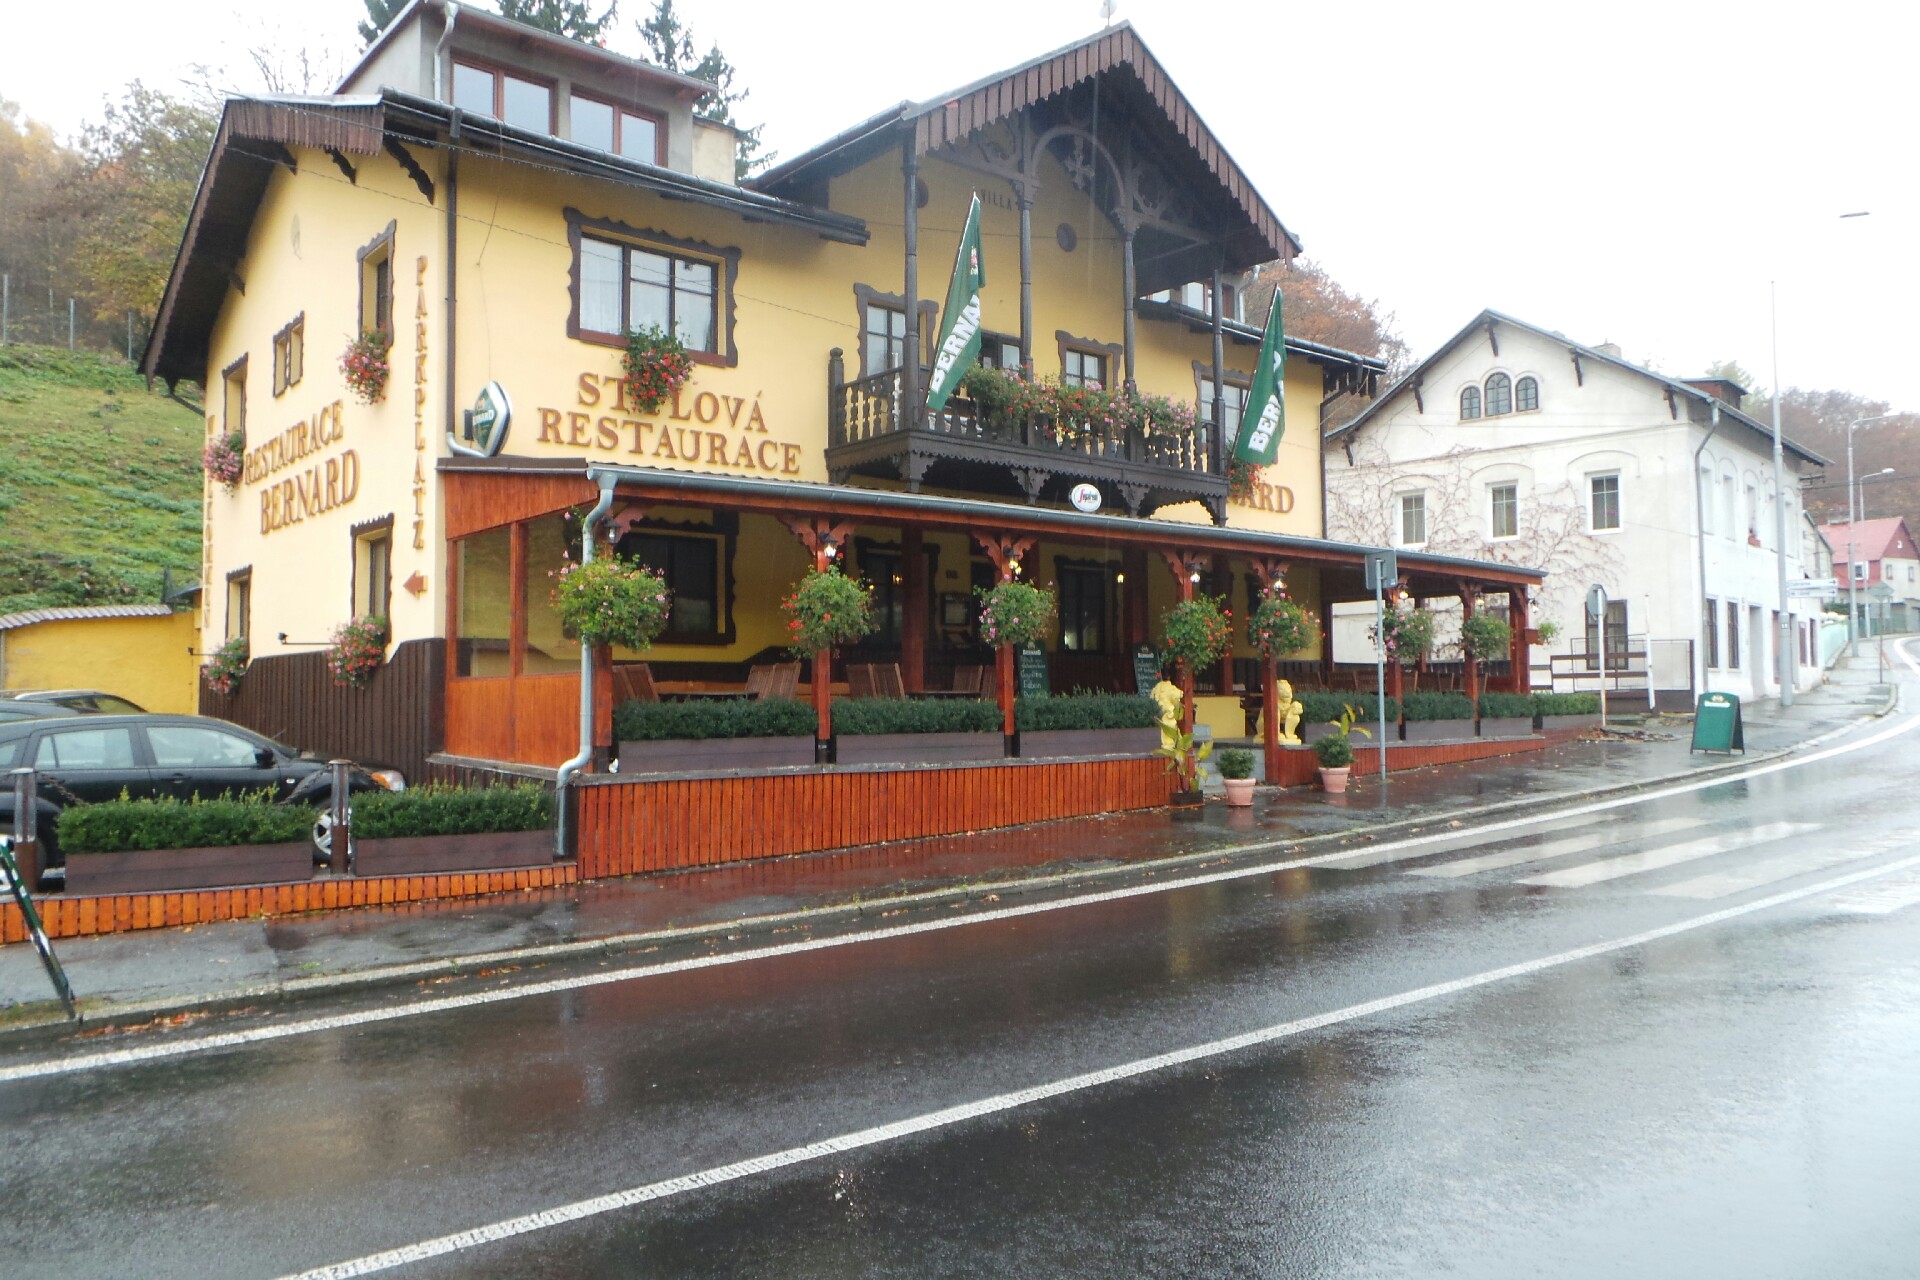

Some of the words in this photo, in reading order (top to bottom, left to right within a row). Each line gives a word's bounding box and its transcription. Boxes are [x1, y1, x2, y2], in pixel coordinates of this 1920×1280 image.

[244, 399, 344, 486] RESTAURACE
[413, 255, 428, 549] PARKPLATZ
[537, 406, 802, 474] RESTAURACE
[577, 371, 769, 433] STLOVÁ
[259, 449, 361, 535] BERNARD
